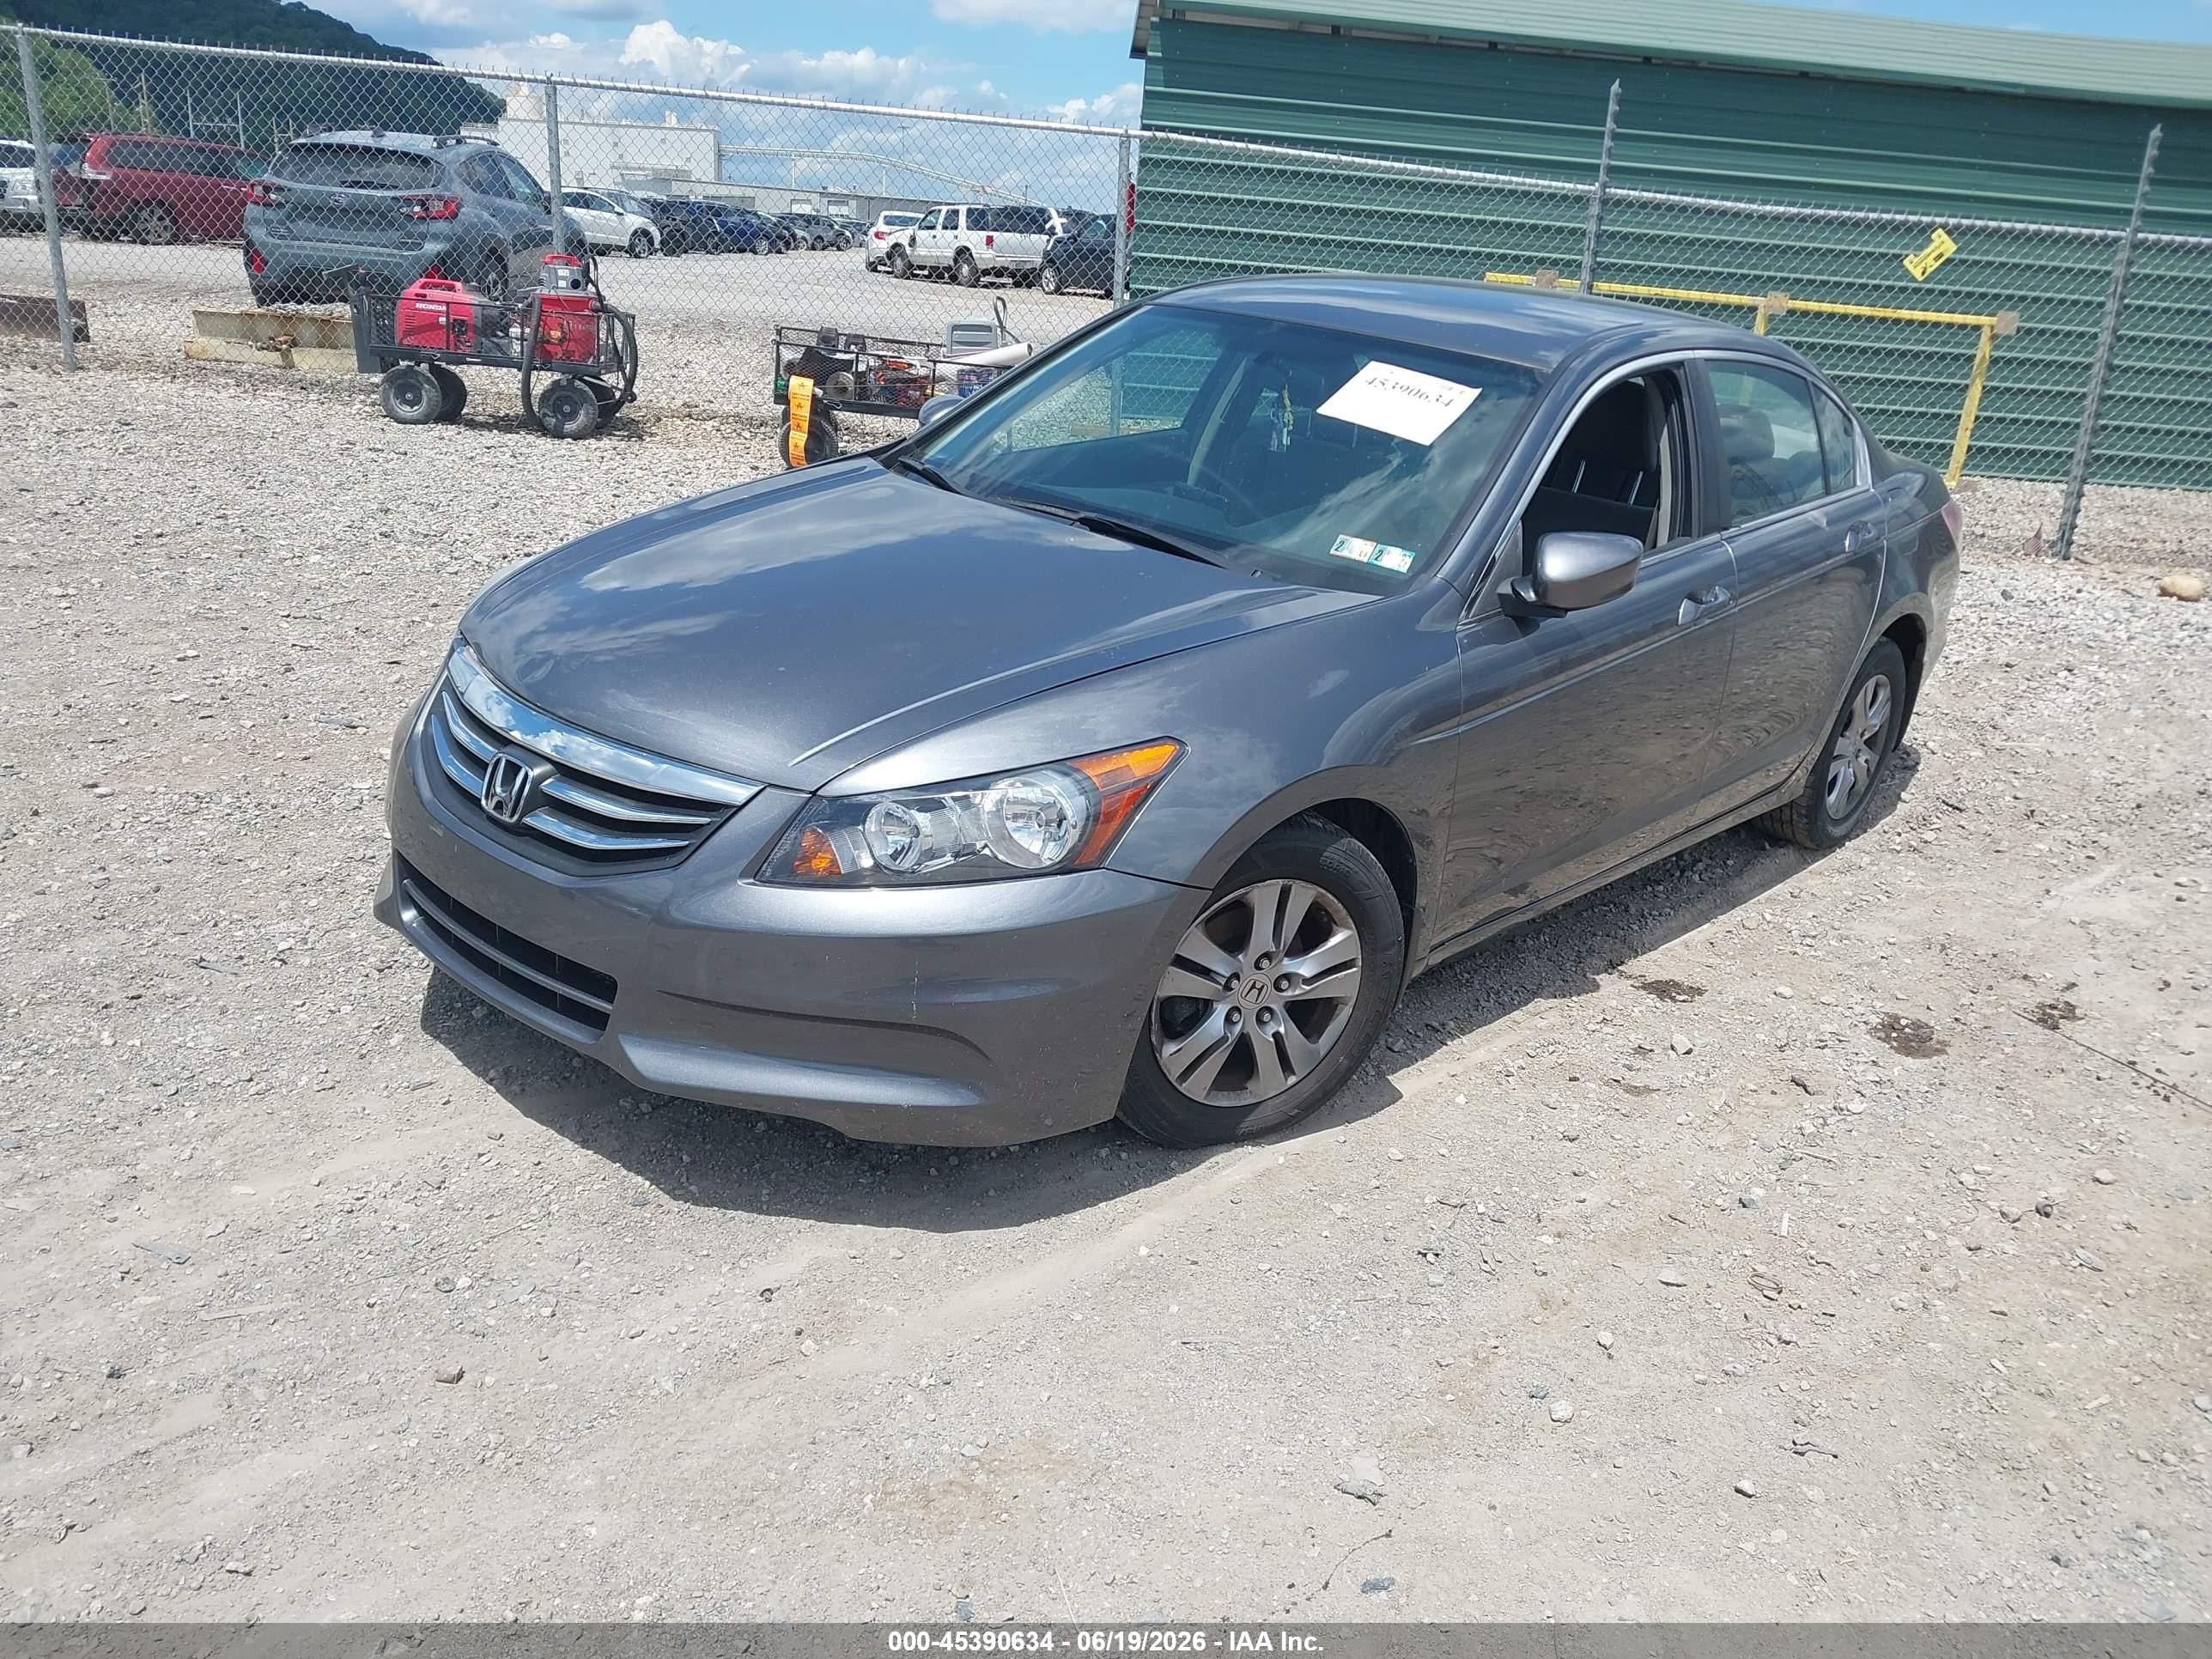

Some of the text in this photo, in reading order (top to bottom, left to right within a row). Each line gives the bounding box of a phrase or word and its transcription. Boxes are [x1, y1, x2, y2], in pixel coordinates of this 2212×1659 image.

[415, 302, 447, 311] HONDA
[1334, 540, 1345, 552] 2
[1374, 549, 1384, 562] 2
